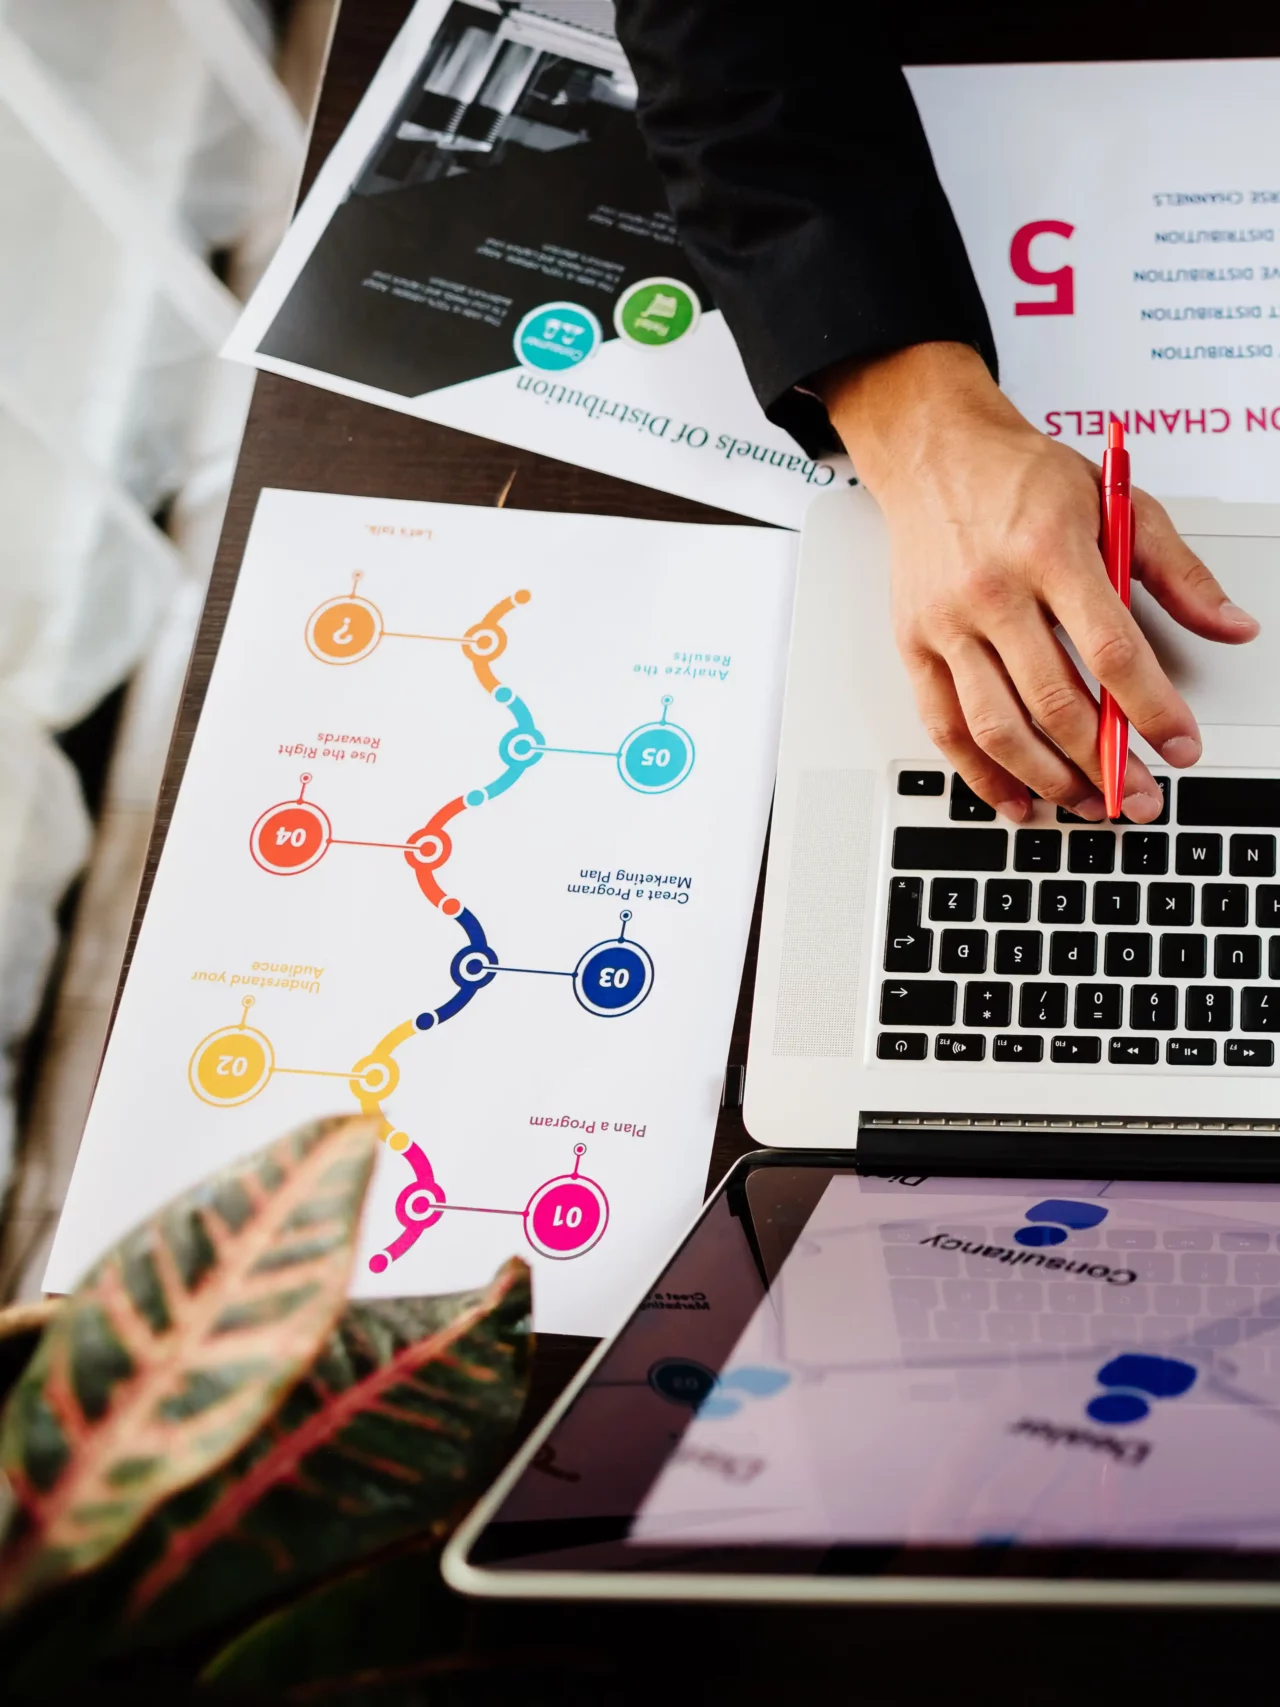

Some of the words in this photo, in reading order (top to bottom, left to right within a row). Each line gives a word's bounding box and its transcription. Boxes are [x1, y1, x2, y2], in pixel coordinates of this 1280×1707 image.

[1153, 191, 1243, 207] CHANNELS
[1154, 228, 1275, 244] DISTRIBUTION
[1009, 220, 1075, 317] 5
[1133, 267, 1254, 282] DISTRIBUTION
[1141, 306, 1262, 321] DISTRIBUTION
[1151, 343, 1273, 360] DISTRIBUTION
[515, 375, 671, 437] Distribution
[1044, 408, 1231, 438] CHANNELS
[671, 420, 710, 449] Of
[715, 434, 836, 488] Channels
[400, 527, 433, 540] Let's
[333, 617, 353, 645] ?
[674, 652, 731, 666] Results
[633, 663, 658, 676] the
[664, 663, 729, 681] Analyze
[317, 733, 380, 748] Rewards
[278, 744, 318, 759] Right
[322, 749, 345, 761] the
[350, 751, 377, 764] Use
[641, 747, 671, 767] 05
[276, 827, 306, 847] 04
[1193, 848, 1206, 860] M
[1248, 849, 1258, 861] N
[580, 870, 611, 883] Plan
[616, 869, 692, 889] Marketing
[567, 884, 631, 900] Program
[636, 890, 644, 899] a
[648, 890, 689, 904] Creat
[948, 893, 958, 908] Ž
[1002, 895, 1012, 910] Ć
[1057, 896, 1066, 911] Č
[1113, 897, 1120, 908] L
[1166, 898, 1175, 910] K
[1222, 899, 1228, 911] J
[958, 945, 969, 957] Đ
[1014, 946, 1022, 962] Š
[1068, 948, 1077, 960] P
[1123, 948, 1134, 961] O
[1233, 951, 1243, 963] U
[191, 971, 226, 981] your
[251, 962, 324, 979] Audience
[598, 967, 630, 988] 03
[230, 975, 320, 994] Understand
[984, 992, 992, 1000] +
[1040, 991, 1047, 1002] /
[1094, 992, 1103, 1004] 0
[1151, 993, 1158, 1005] 9
[1206, 994, 1214, 1006] 8
[1261, 995, 1268, 1007] 7
[1039, 1009, 1046, 1020] ?
[938, 1038, 951, 1047] F12
[995, 1038, 1007, 1047] F11
[1054, 1039, 1066, 1047] F10
[1111, 1040, 1121, 1049] F9
[1169, 1041, 1180, 1049] F8
[1228, 1043, 1238, 1051] F7
[216, 1055, 248, 1077] 02
[529, 1116, 595, 1133] Program
[601, 1122, 609, 1131] a
[614, 1123, 647, 1138] Plan
[552, 1206, 583, 1228] 01
[920, 1233, 1138, 1287] Consultancy
